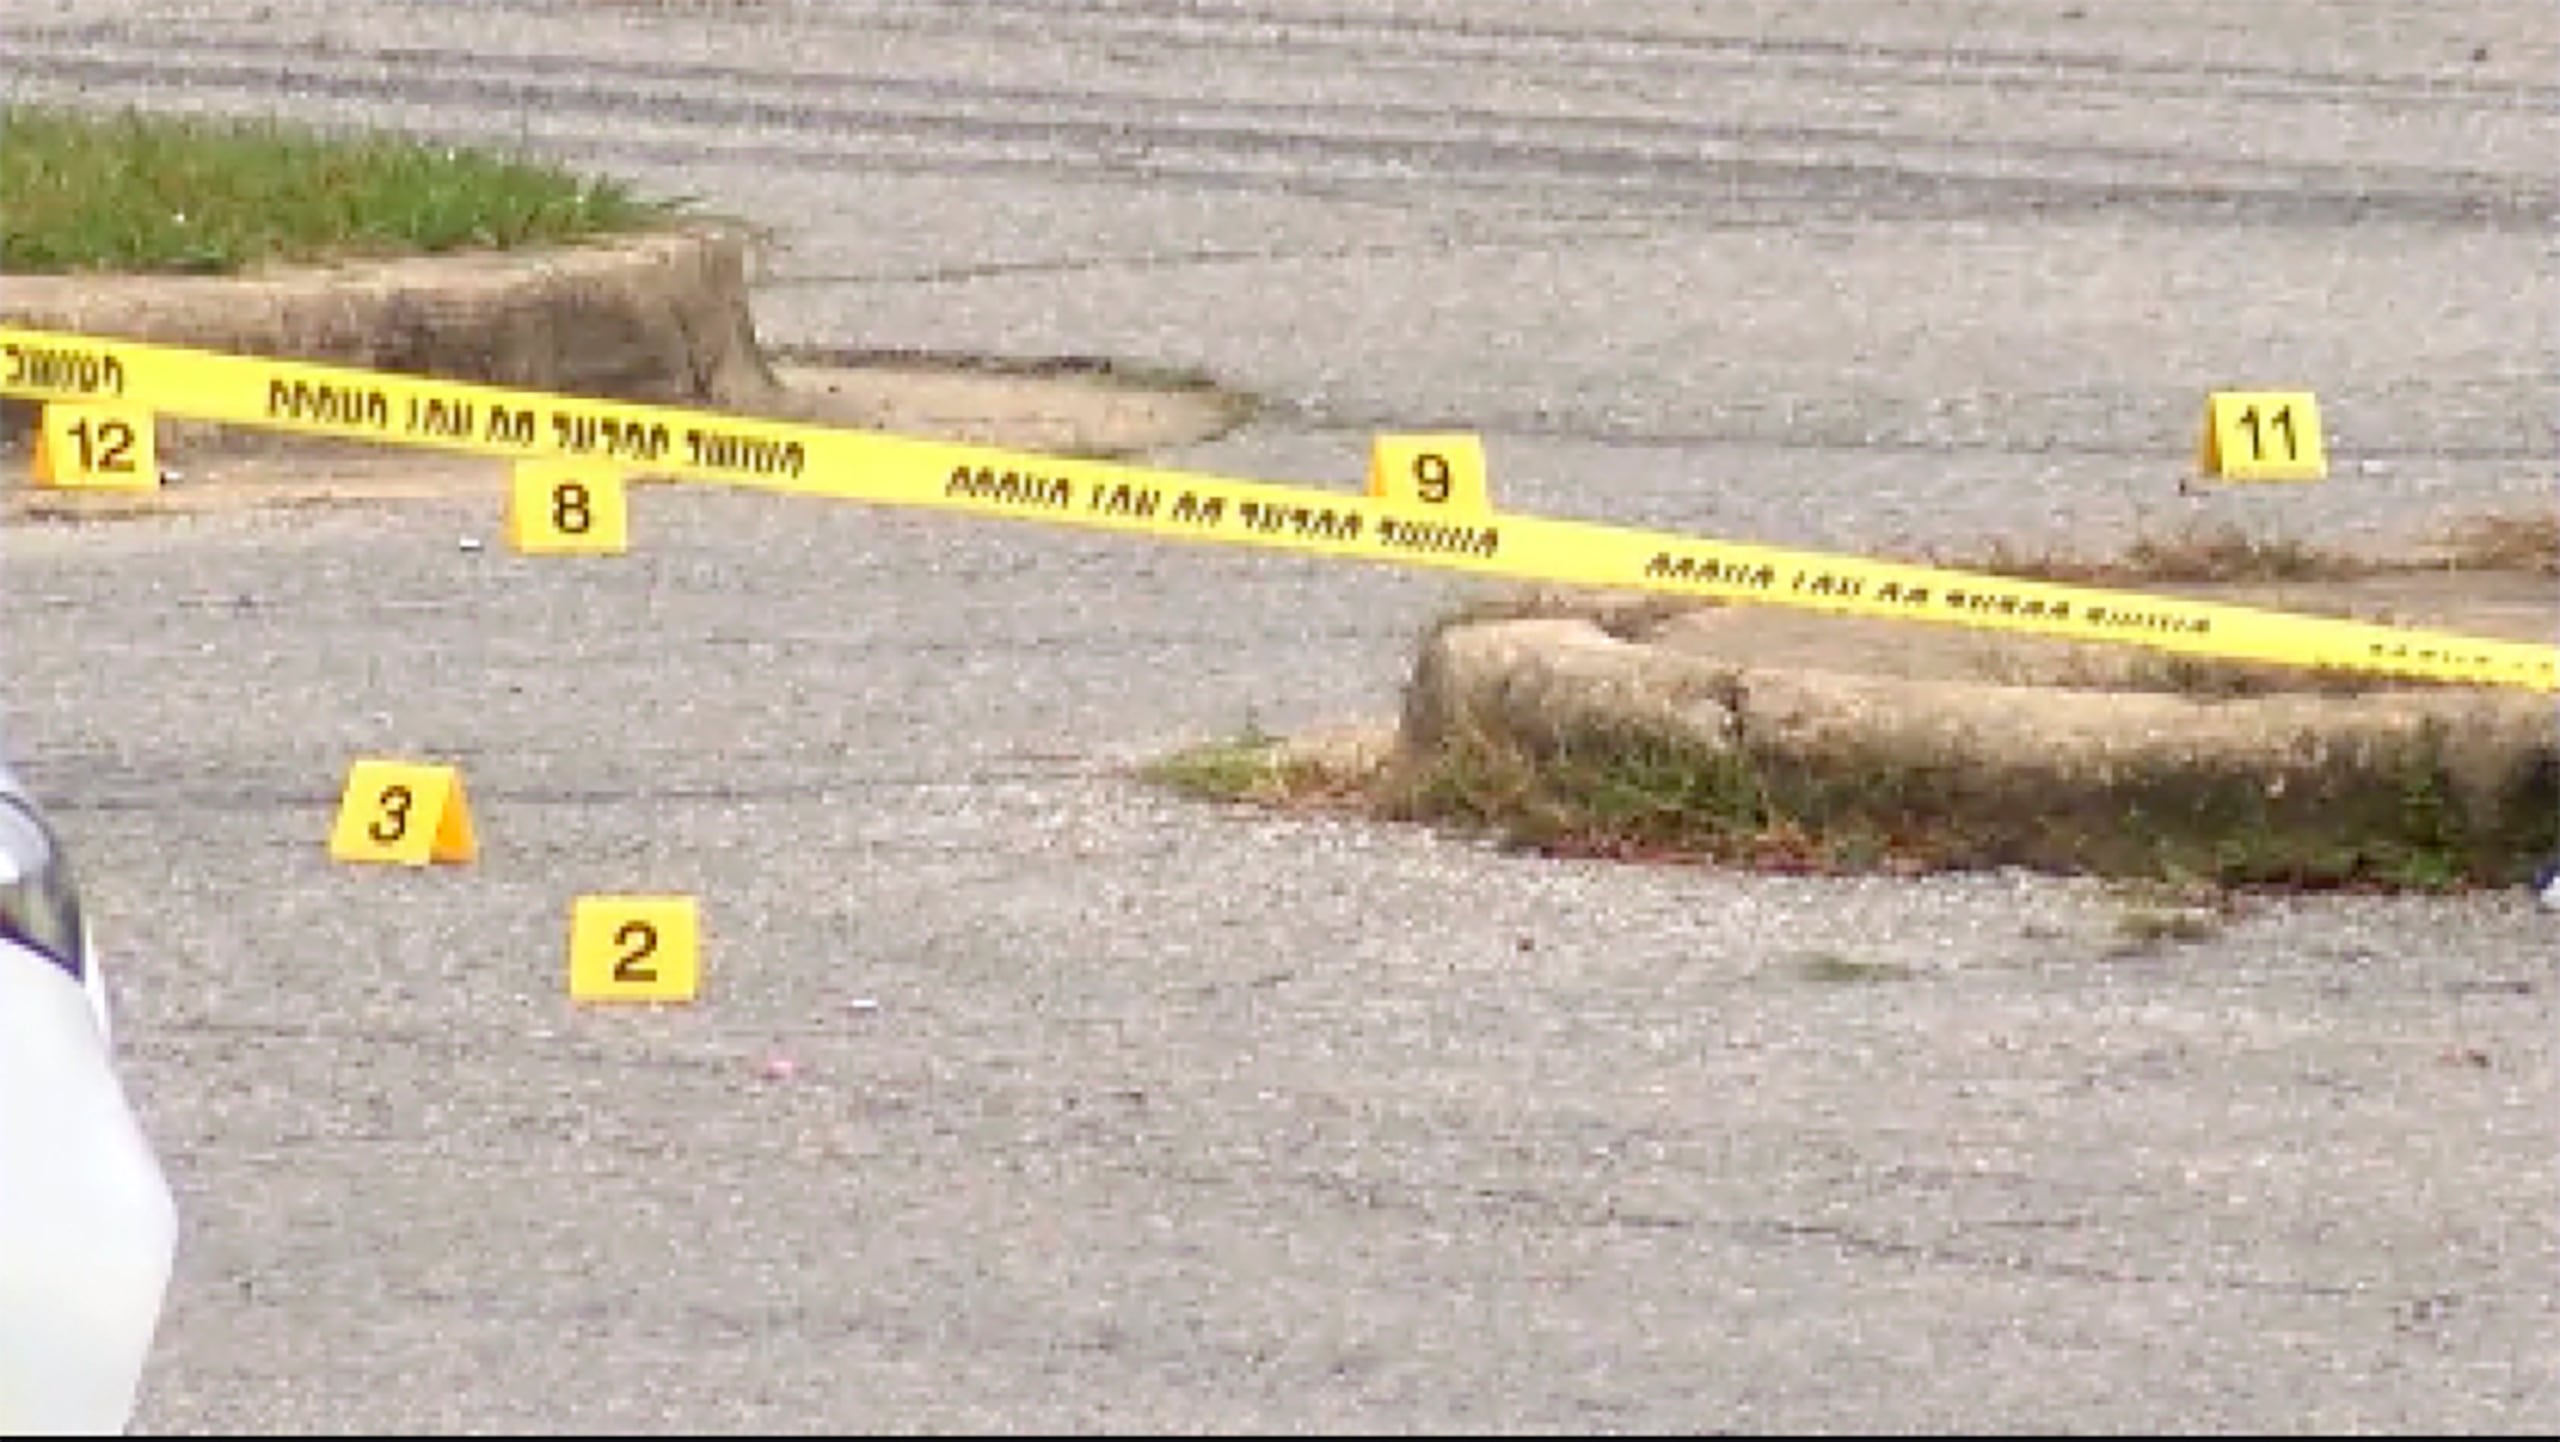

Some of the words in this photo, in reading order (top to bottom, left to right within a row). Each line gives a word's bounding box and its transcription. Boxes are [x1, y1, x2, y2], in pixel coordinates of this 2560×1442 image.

[67, 419, 135, 472] 12
[2240, 405, 2296, 460] 11
[1413, 454, 1450, 503] 9
[553, 484, 591, 534] 8
[369, 786, 412, 842] 3
[614, 921, 657, 981] 2
